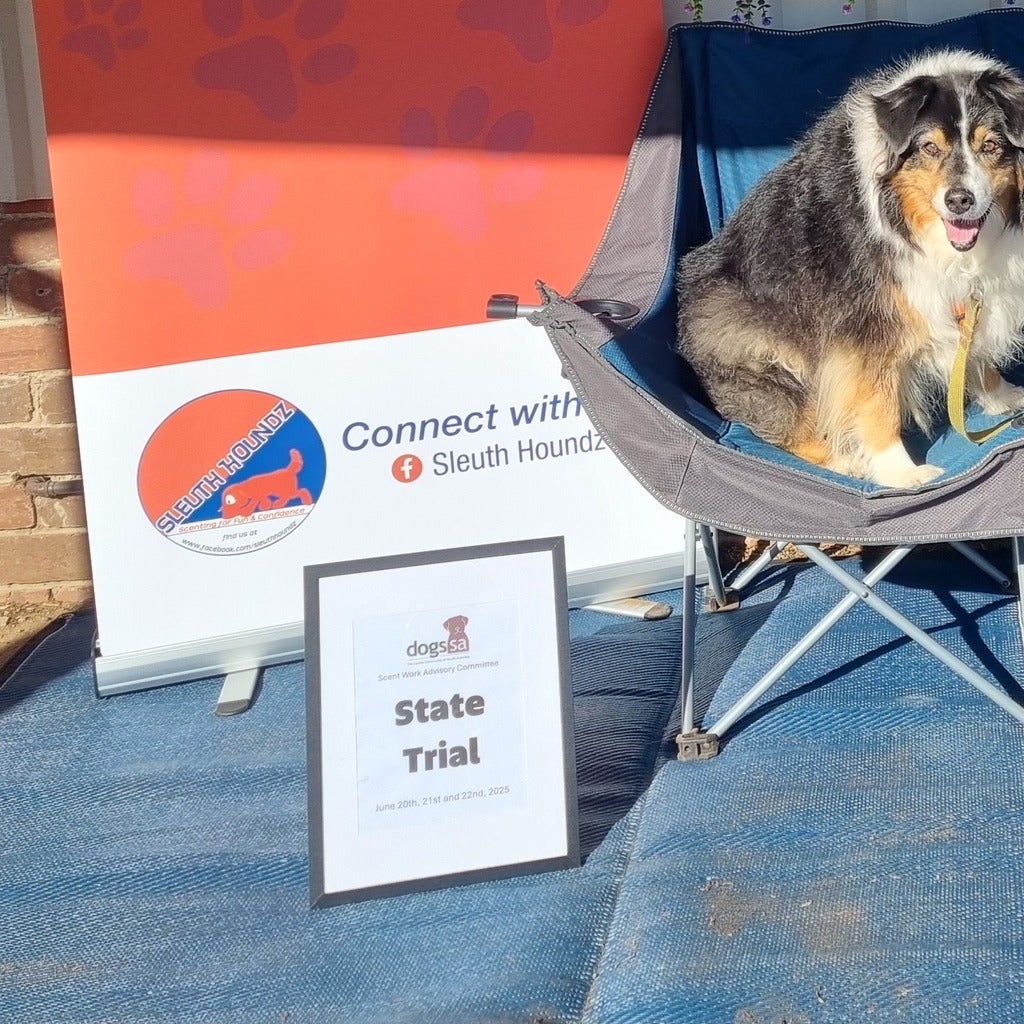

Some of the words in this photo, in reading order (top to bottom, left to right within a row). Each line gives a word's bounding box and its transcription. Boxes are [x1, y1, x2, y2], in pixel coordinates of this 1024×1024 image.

[342, 404, 498, 451] Connect
[510, 391, 583, 426] with
[156, 469, 226, 535] SLEUTH
[217, 400, 296, 476] HOUNDZ
[432, 444, 509, 476] Sleuth
[518, 429, 606, 463] Houndz
[179, 521, 217, 532] Scenting
[218, 519, 232, 529] for
[257, 508, 305, 520] Confidence
[406, 640, 447, 658] dogs
[449, 638, 468, 652] sa
[378, 672, 400, 682] Scent
[401, 669, 421, 679] Work
[423, 665, 456, 677] Advisory
[457, 660, 499, 672] Committee
[395, 693, 485, 726] State
[402, 737, 480, 773] Trial
[375, 802, 396, 812] June
[397, 799, 420, 810] 20th,
[422, 796, 441, 806] 21st
[443, 793, 460, 803] and
[461, 790, 487, 800] 22nd,
[488, 785, 510, 796] 2025
